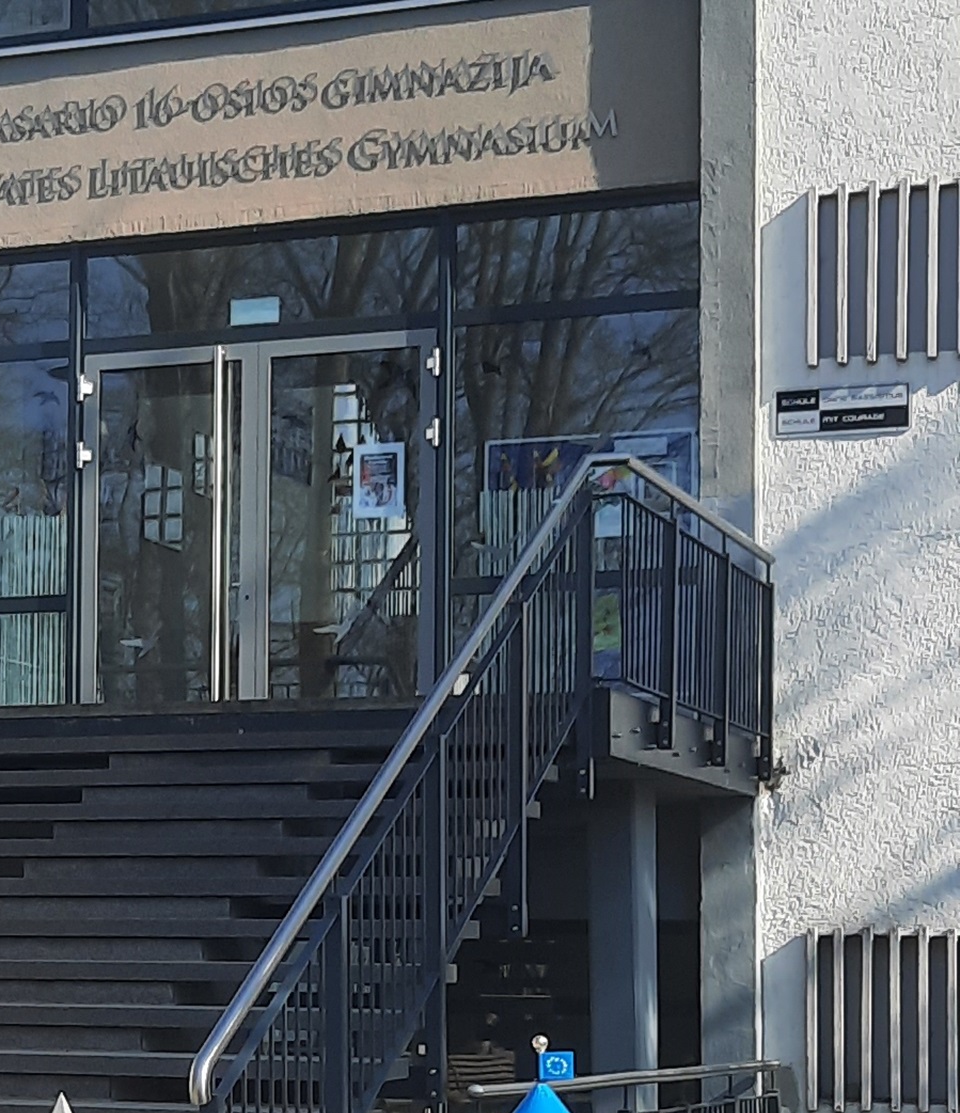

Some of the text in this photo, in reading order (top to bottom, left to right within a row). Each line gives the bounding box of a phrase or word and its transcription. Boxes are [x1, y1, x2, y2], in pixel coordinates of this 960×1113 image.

[134, 72, 318, 130] 16-OSIOS
[87, 137, 343, 200] LITAUISCHES
[347, 108, 618, 171] GYMNASIUM
